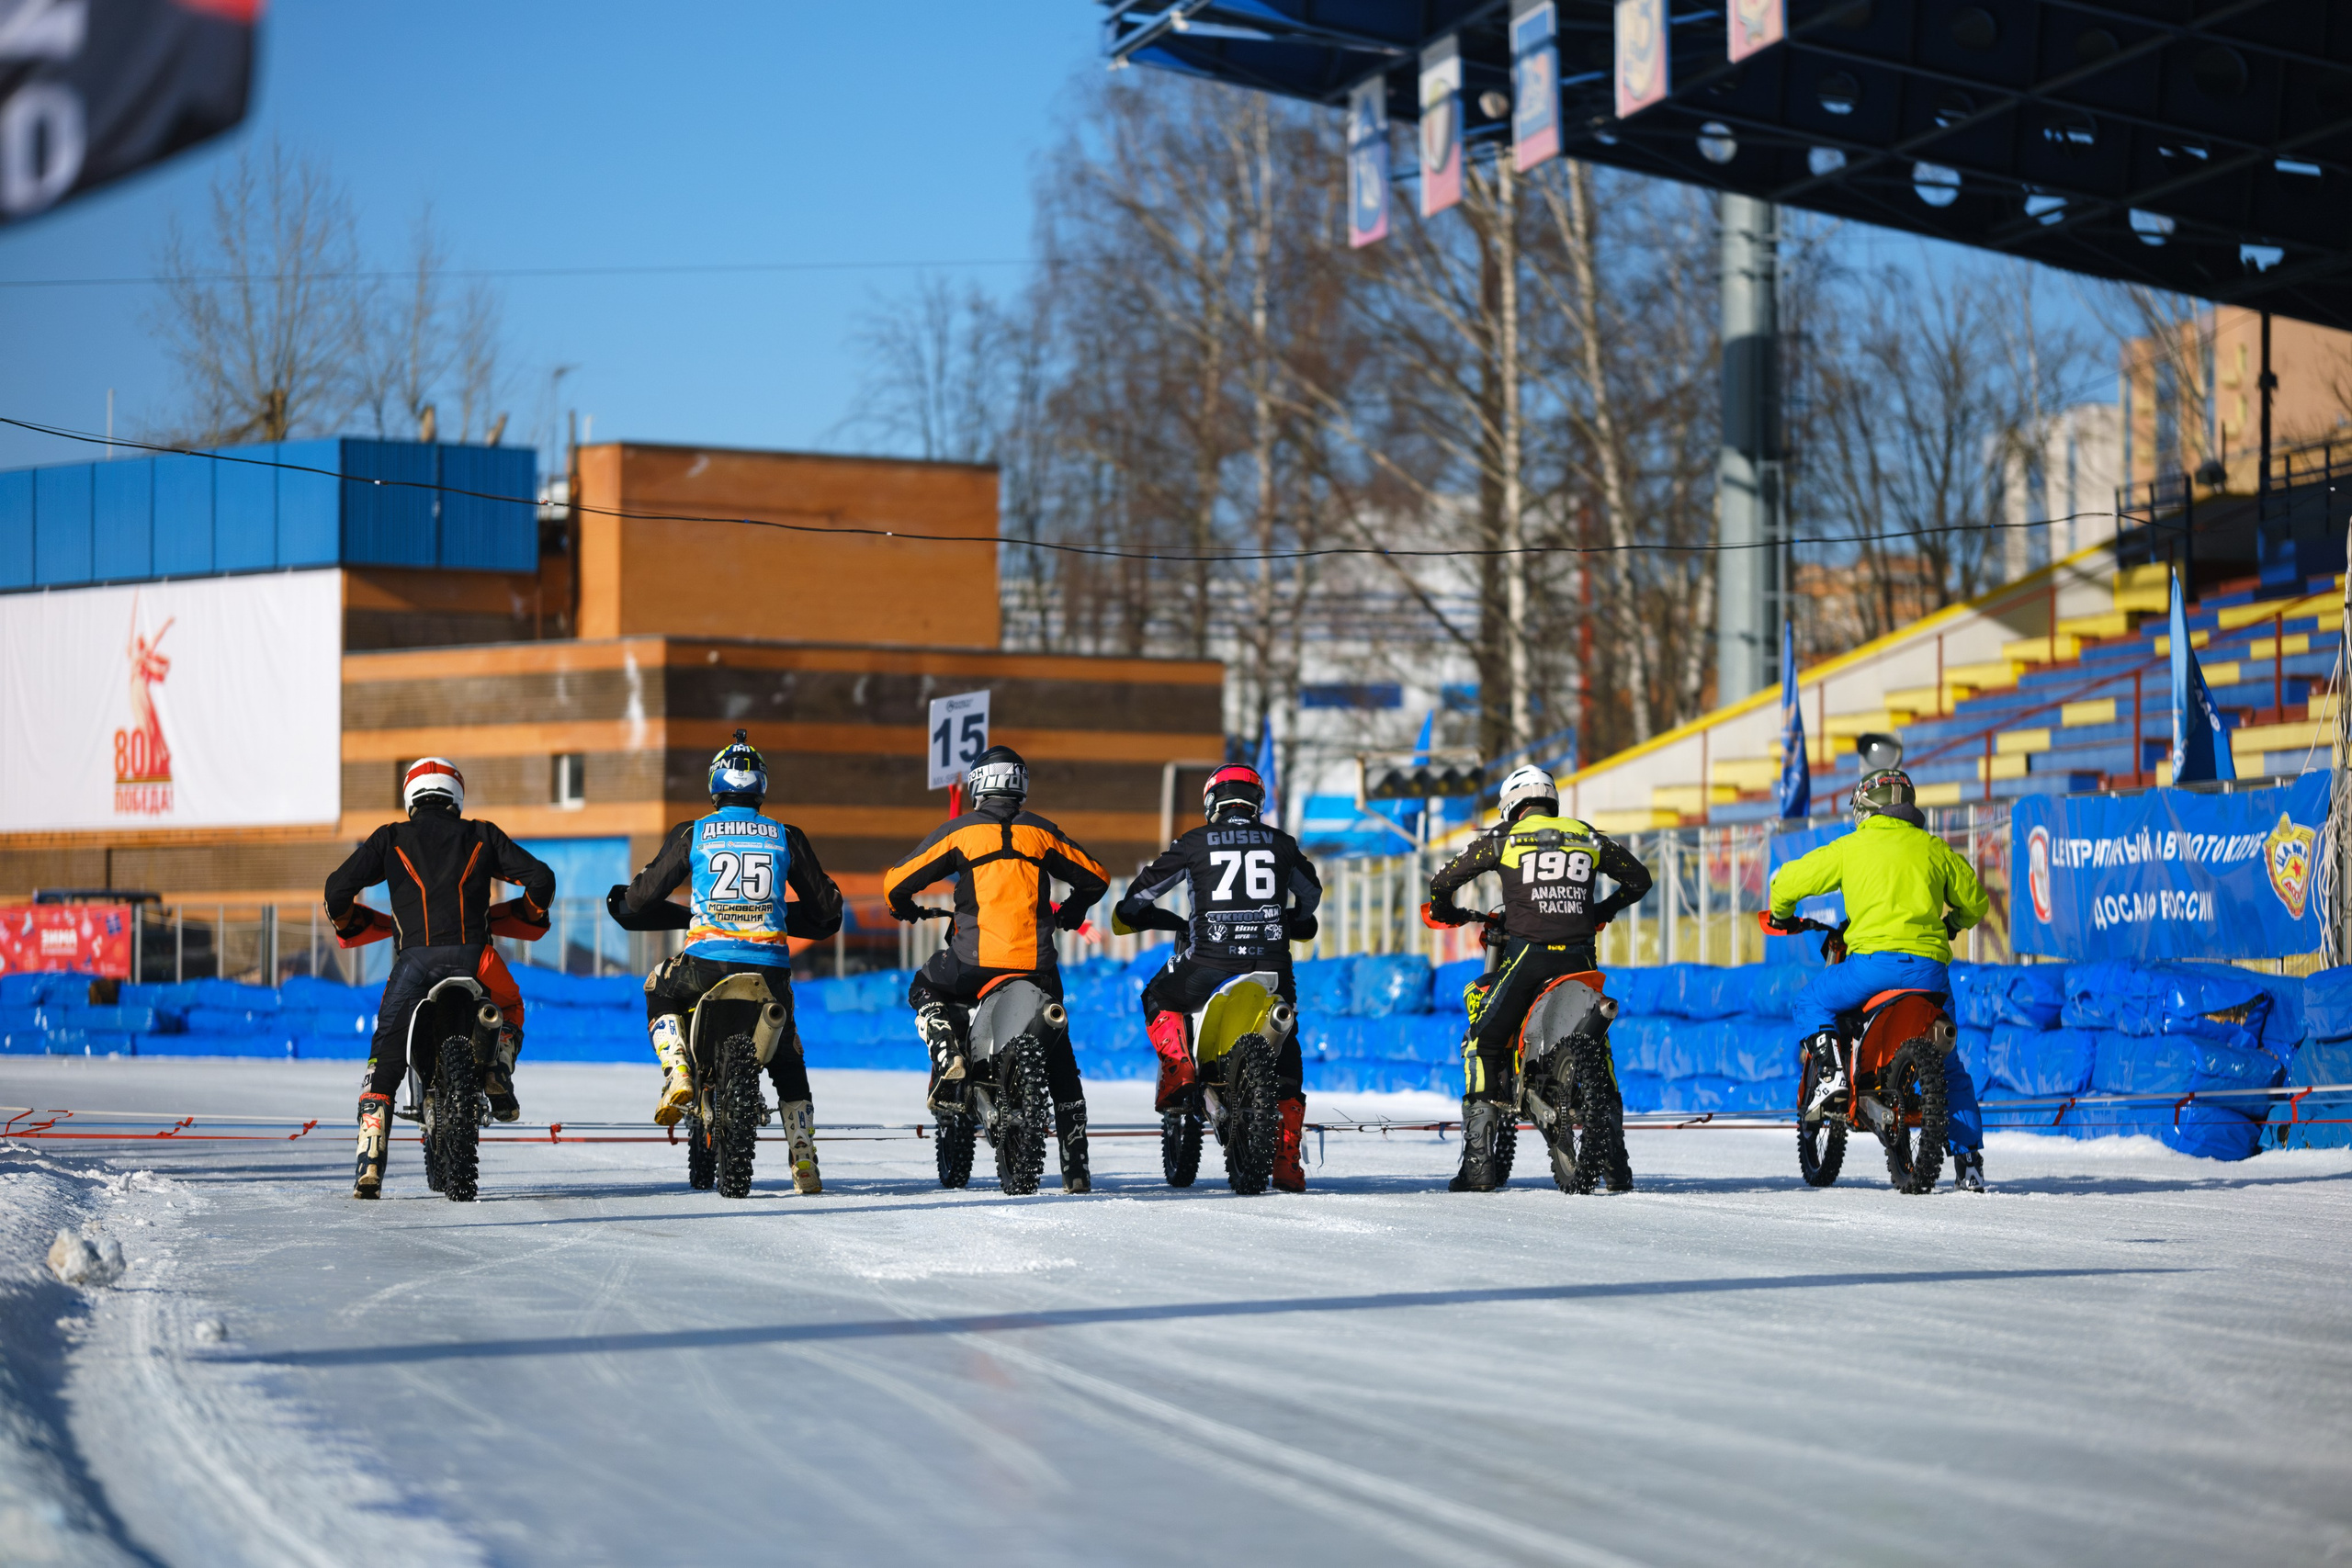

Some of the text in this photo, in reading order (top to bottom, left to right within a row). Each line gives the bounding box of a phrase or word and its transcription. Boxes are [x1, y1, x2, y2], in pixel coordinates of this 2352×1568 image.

[114, 728, 147, 777] 80
[933, 712, 986, 769] 15
[114, 784, 174, 815] ПОБЕДА!
[702, 821, 779, 840] ДЕНИСОВ
[1207, 829, 1274, 846] GUSEV
[709, 852, 773, 902] 25
[1209, 851, 1275, 900] 76
[1521, 851, 1593, 884] 198
[1531, 886, 1588, 901] ANARCHY
[2160, 889, 2213, 922] РОССИИ
[708, 903, 773, 913] МОСКОВСКАЯ
[717, 912, 763, 922] ПОЛИЦИЯ
[1208, 911, 1265, 922] TIKHON
[1538, 900, 1584, 915] RACING
